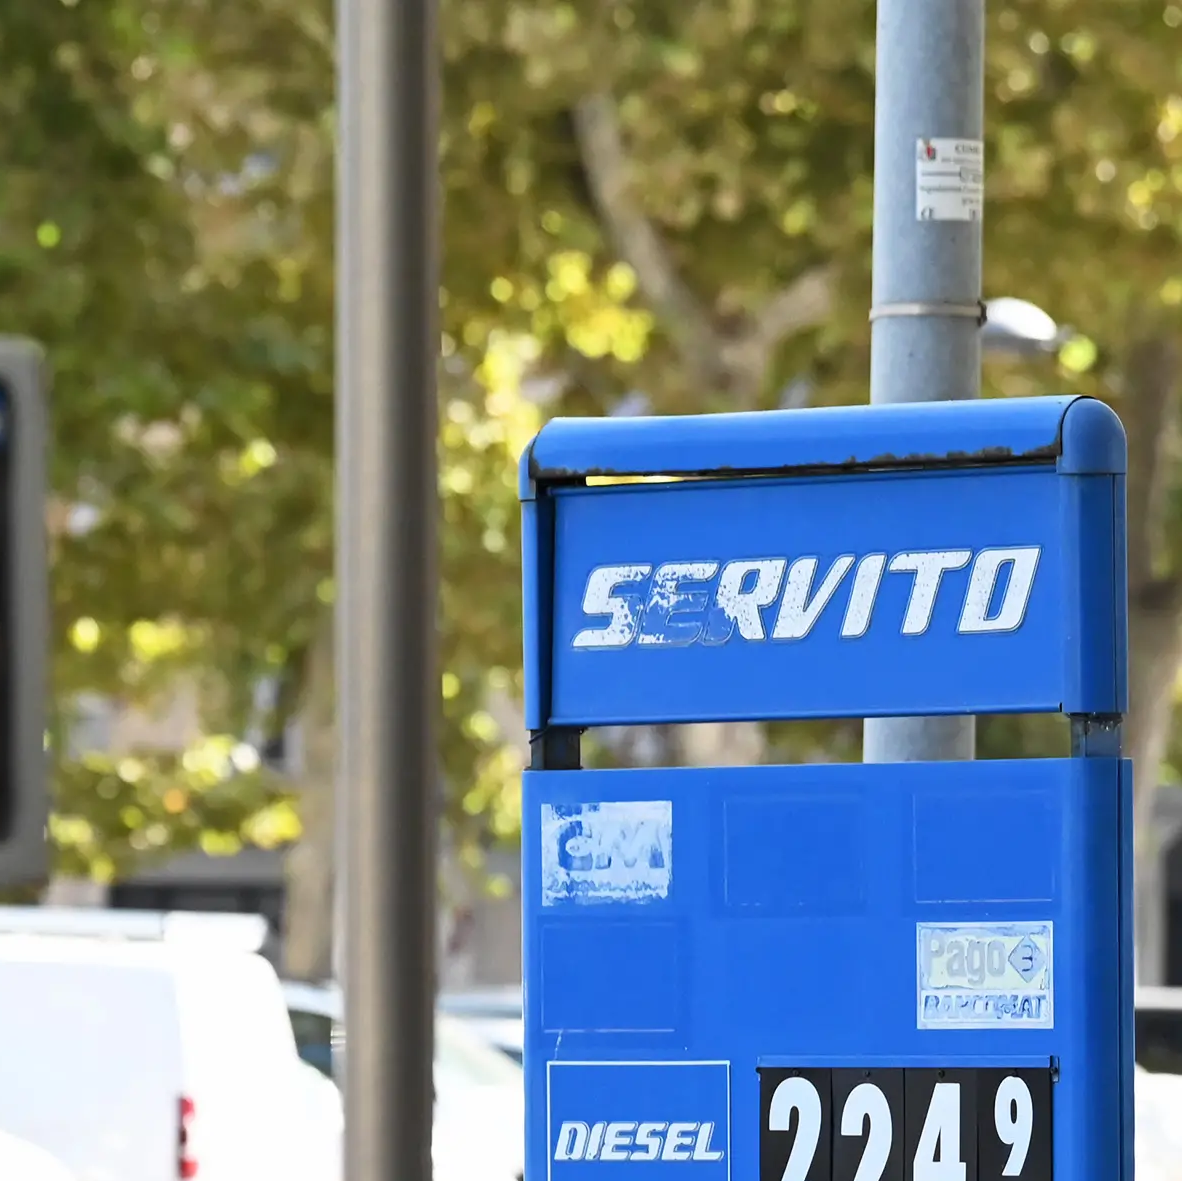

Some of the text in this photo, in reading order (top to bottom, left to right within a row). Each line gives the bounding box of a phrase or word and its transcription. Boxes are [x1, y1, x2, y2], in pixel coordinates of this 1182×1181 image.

[571, 547, 1042, 649] SERVITO
[921, 930, 1006, 986] Pago
[554, 1120, 724, 1161] DIESEL
